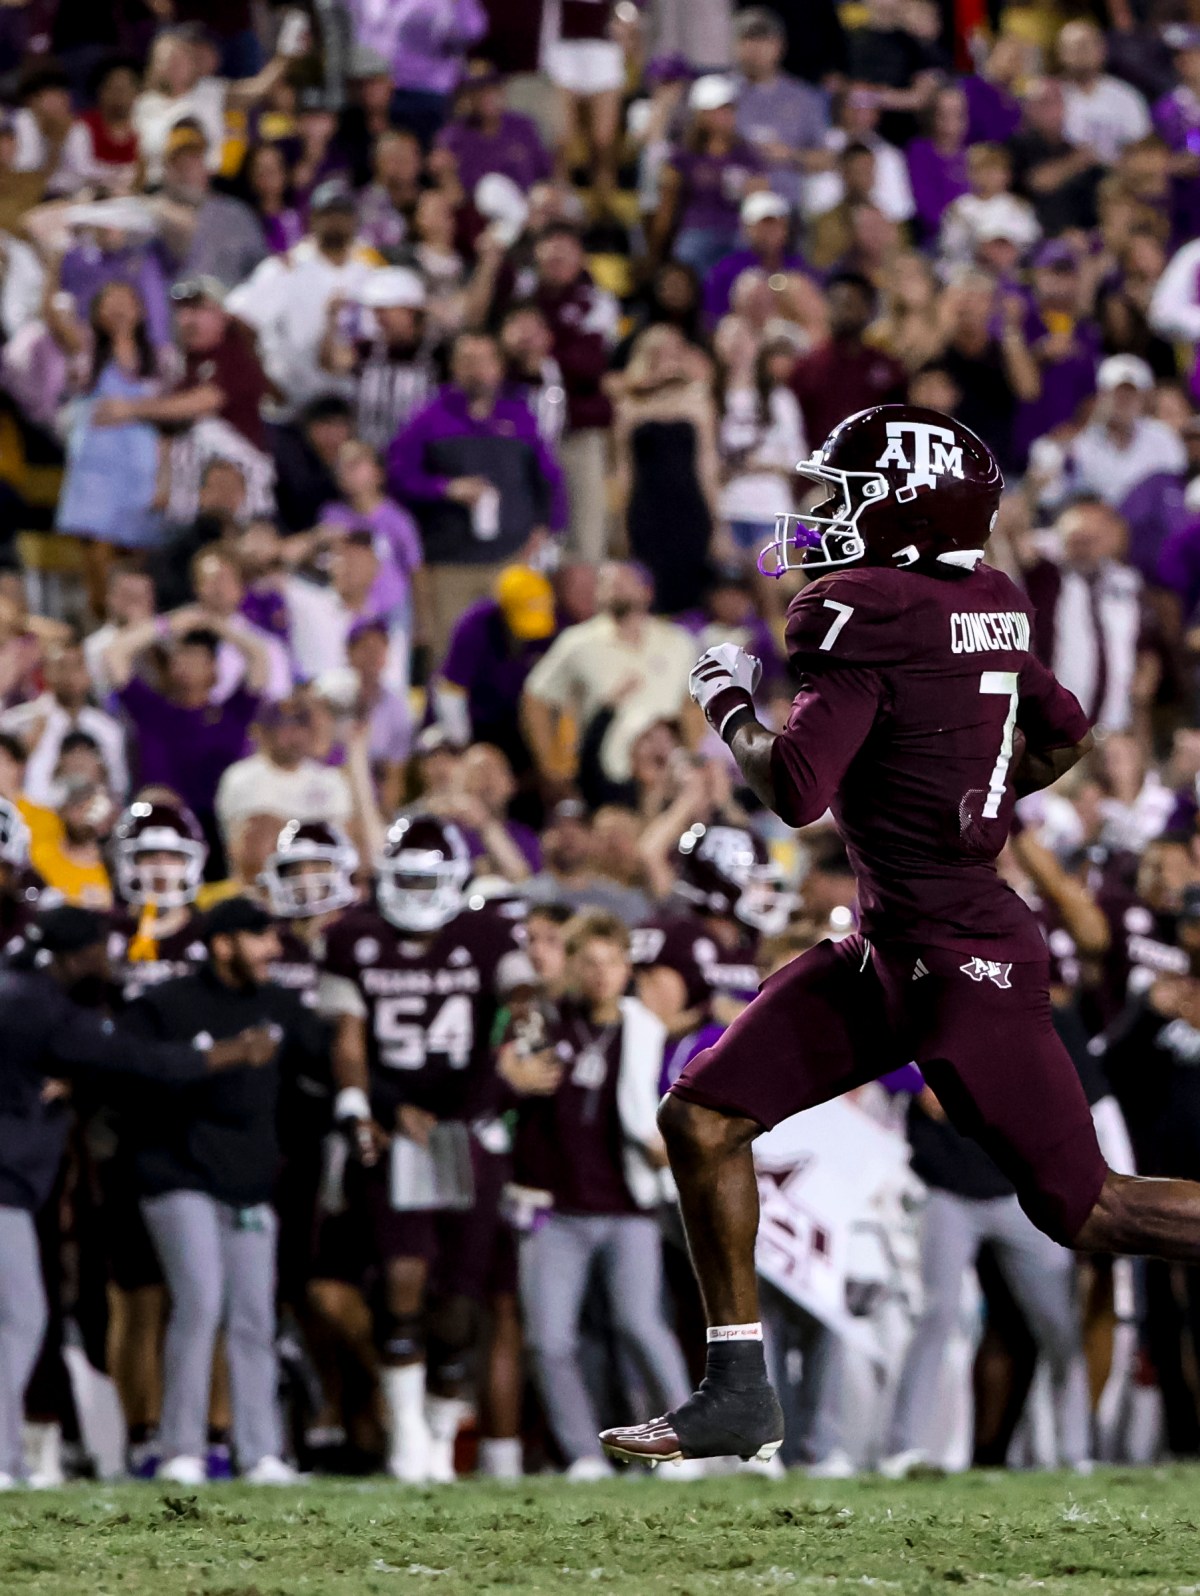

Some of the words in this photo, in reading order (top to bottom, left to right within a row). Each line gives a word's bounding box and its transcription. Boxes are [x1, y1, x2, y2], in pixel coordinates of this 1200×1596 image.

[819, 598, 855, 652] 7
[979, 671, 1019, 819] 7
[374, 995, 473, 1070] 54
